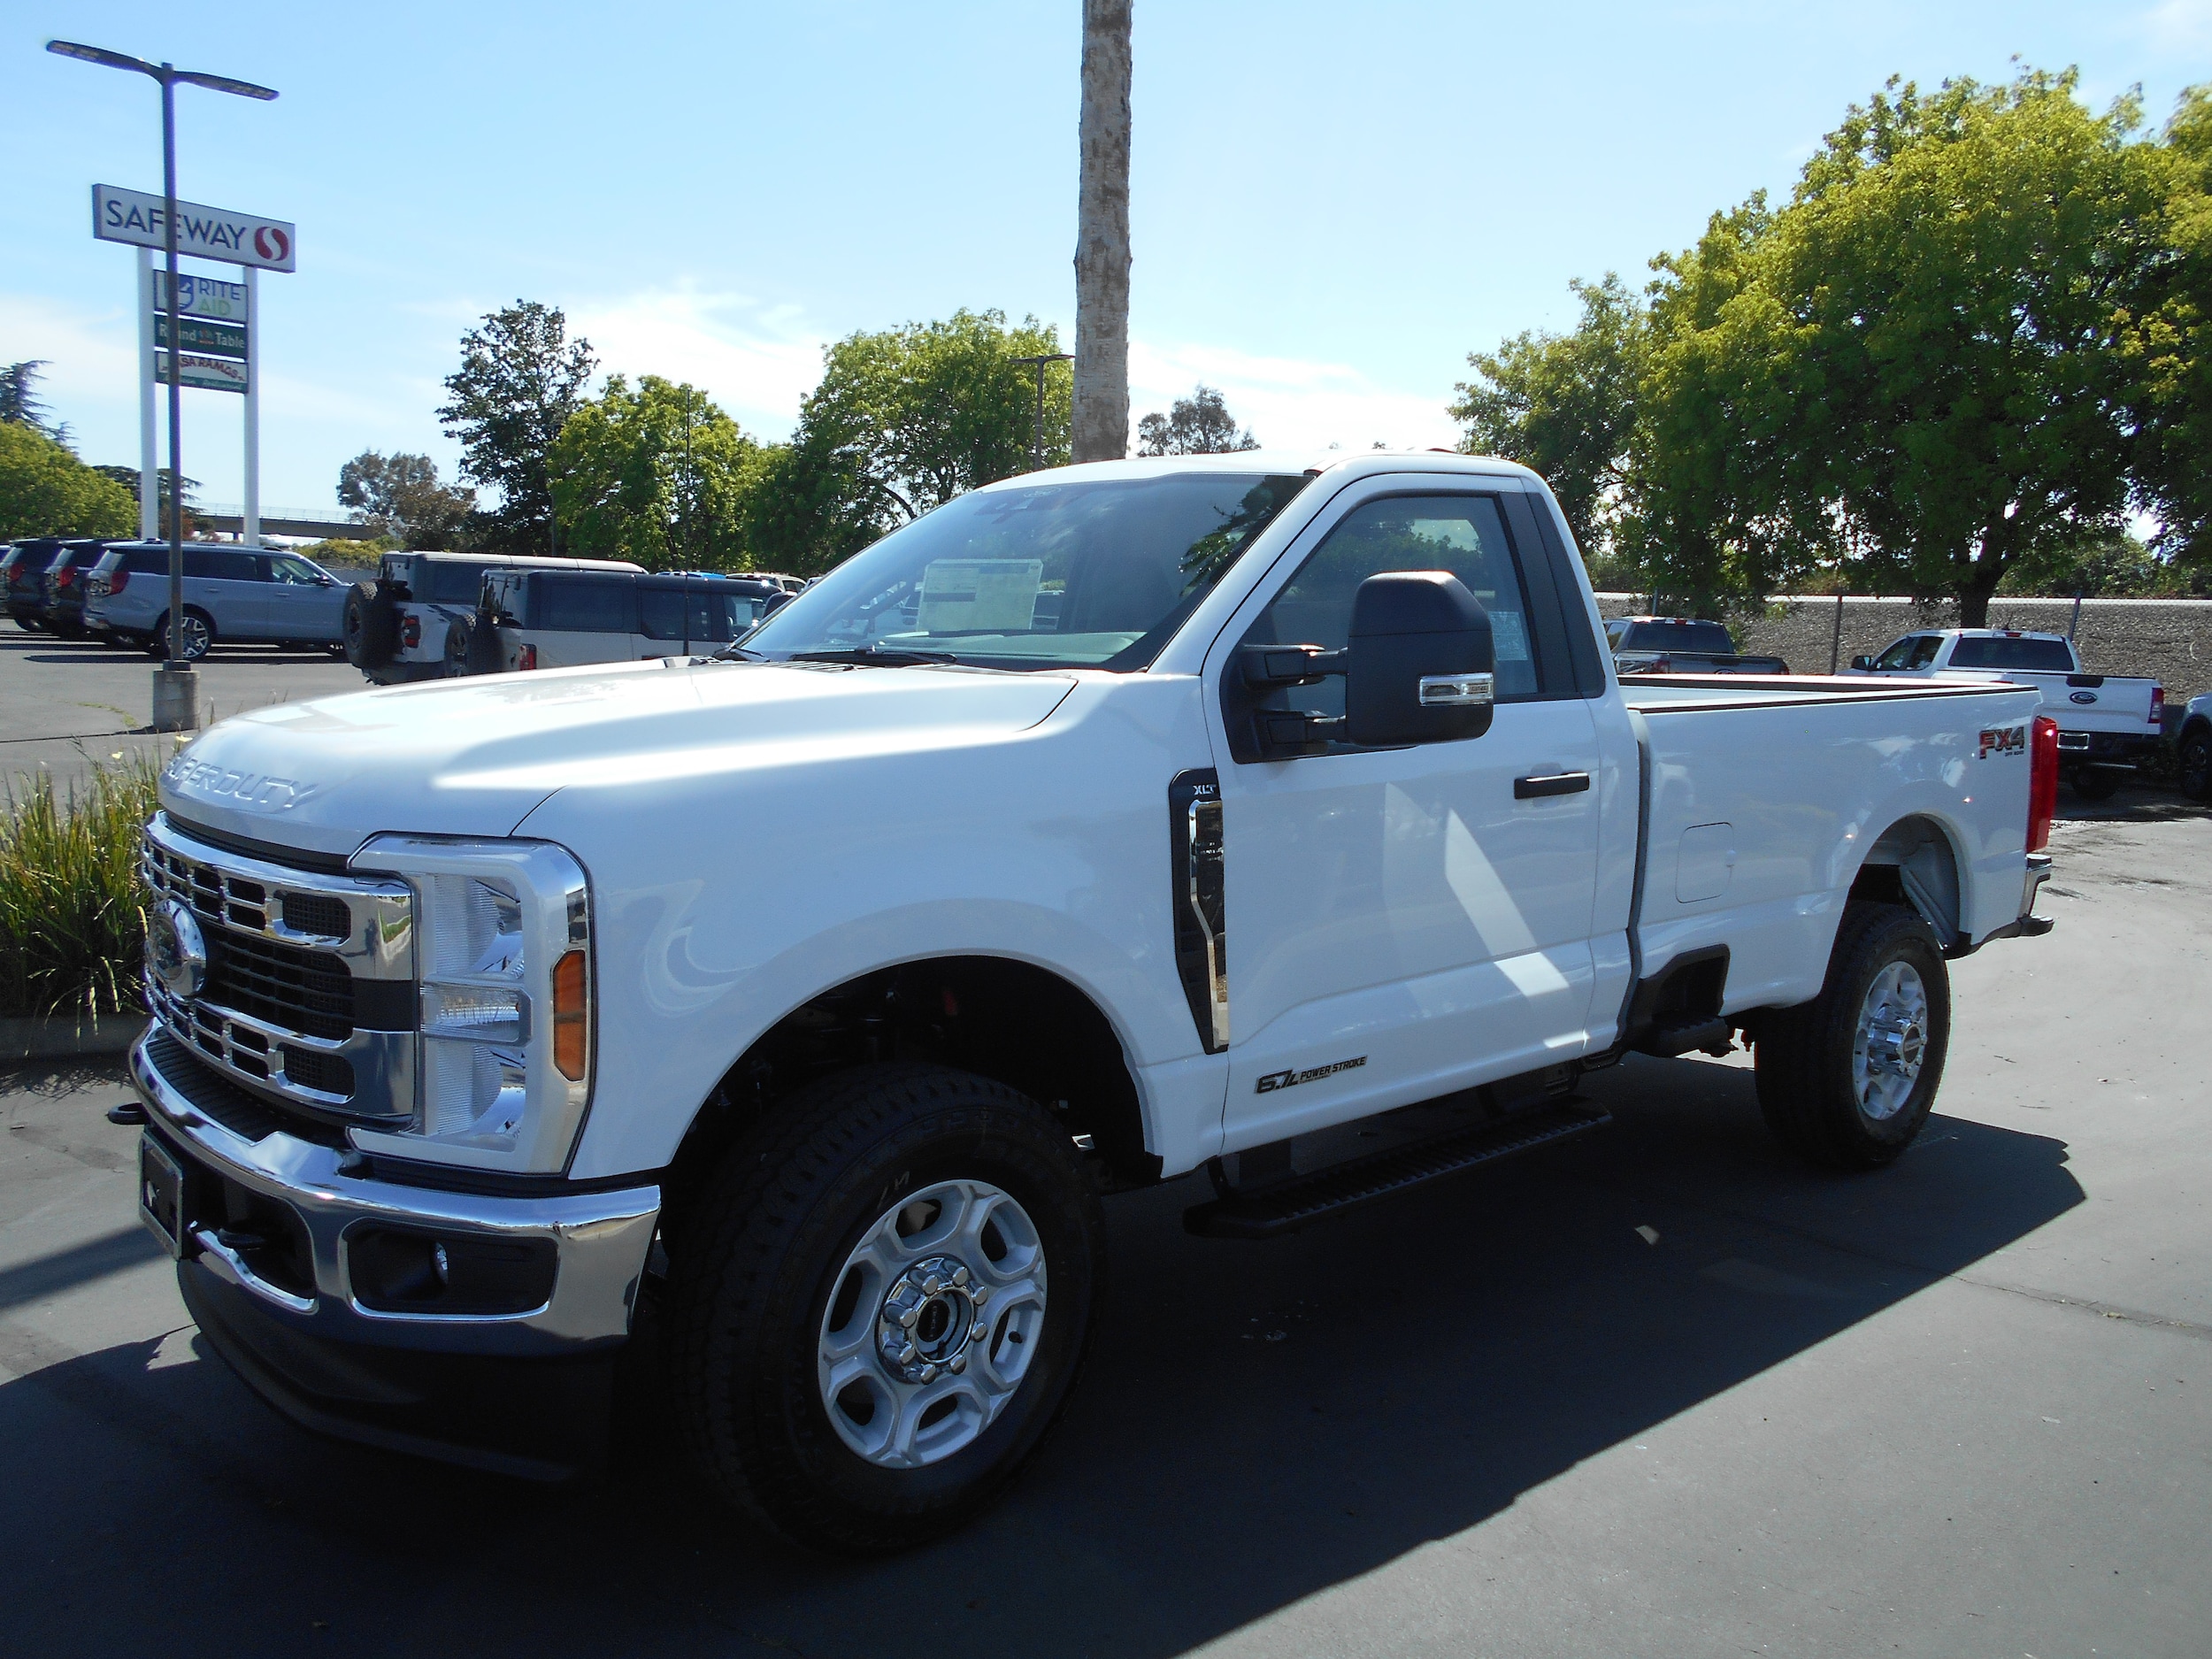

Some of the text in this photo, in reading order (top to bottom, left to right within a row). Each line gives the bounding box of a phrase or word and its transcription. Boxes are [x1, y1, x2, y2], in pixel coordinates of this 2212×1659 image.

[199, 278, 241, 301] RITE
[198, 299, 231, 316] AID
[160, 323, 245, 349] Rnd Table
[1979, 726, 2024, 760] FX4
[214, 769, 319, 808] DUTY
[1193, 784, 1217, 795] XLT
[1256, 1069, 1299, 1094] 6.7L
[1300, 1064, 1332, 1081] POWER
[1332, 1056, 1366, 1073] STROKE
